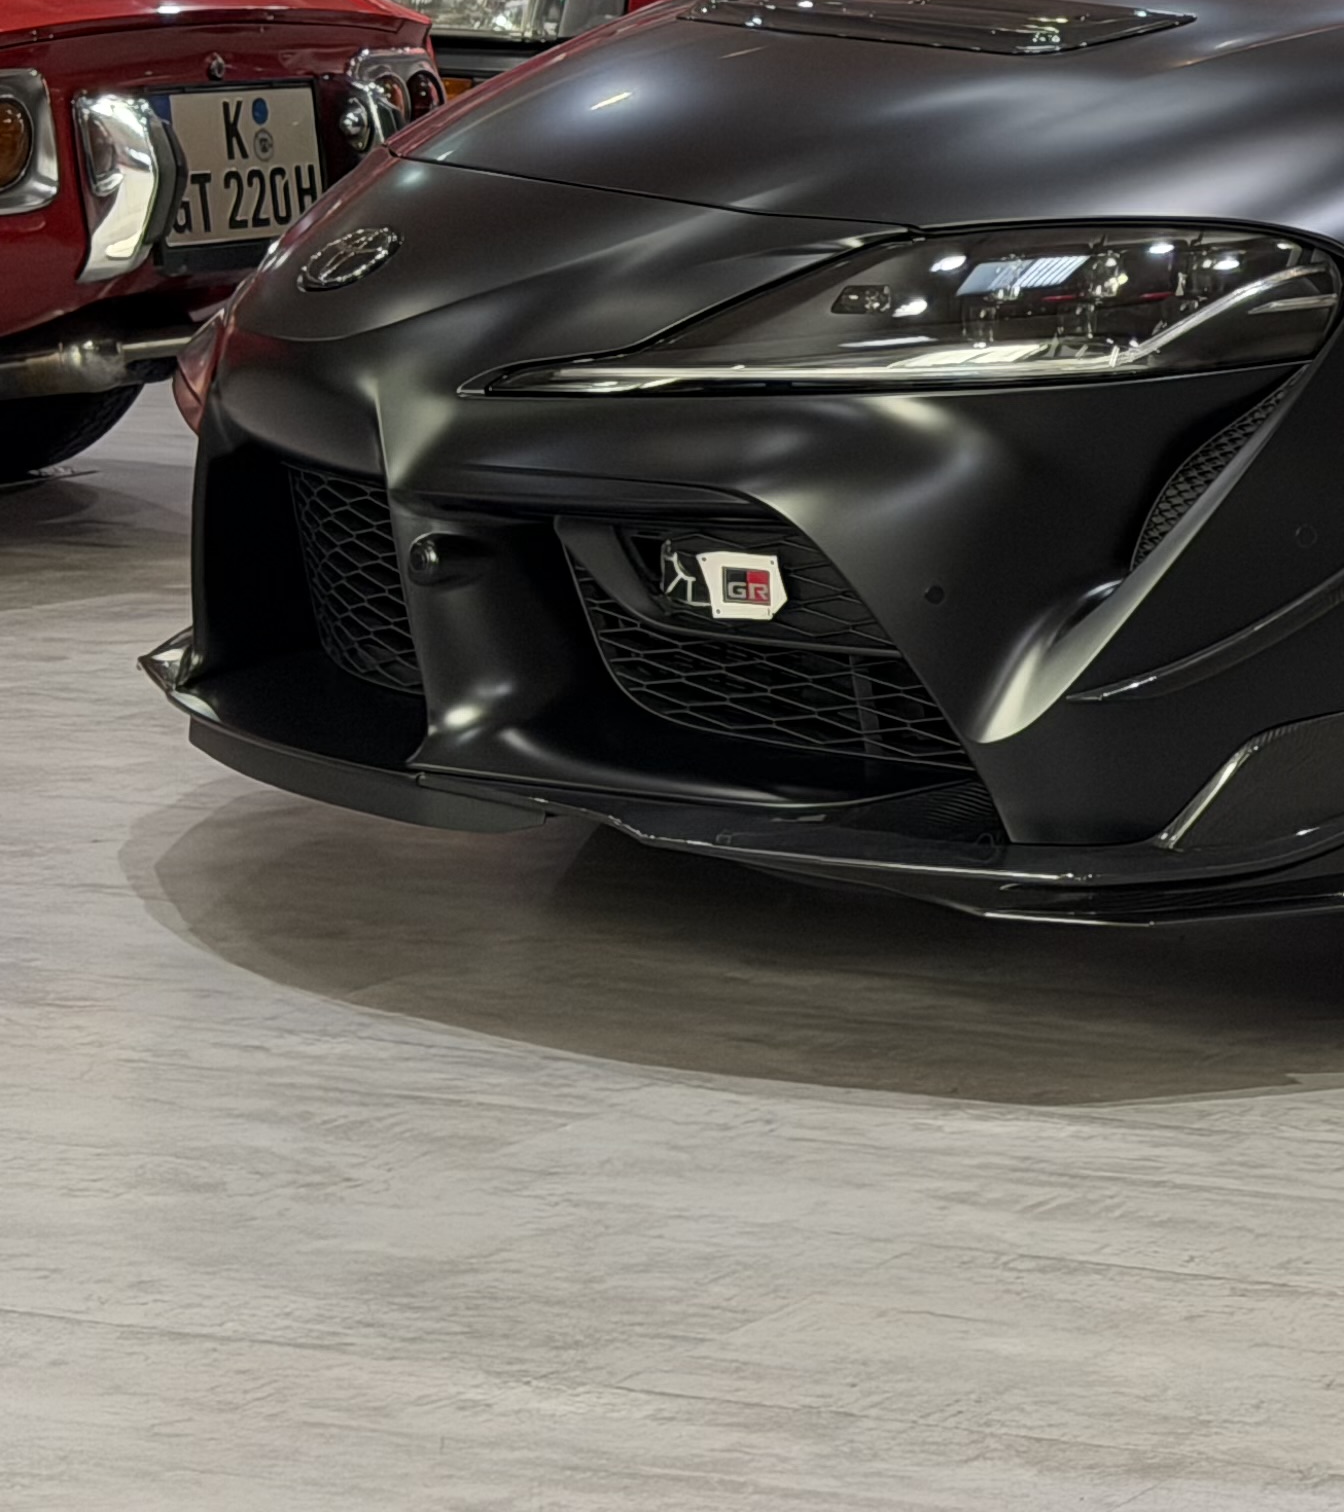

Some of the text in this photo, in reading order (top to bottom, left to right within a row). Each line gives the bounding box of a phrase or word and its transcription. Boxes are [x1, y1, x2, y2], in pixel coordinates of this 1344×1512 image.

[222, 100, 249, 160] K
[224, 164, 318, 229] 220H
[728, 581, 769, 601] GR
